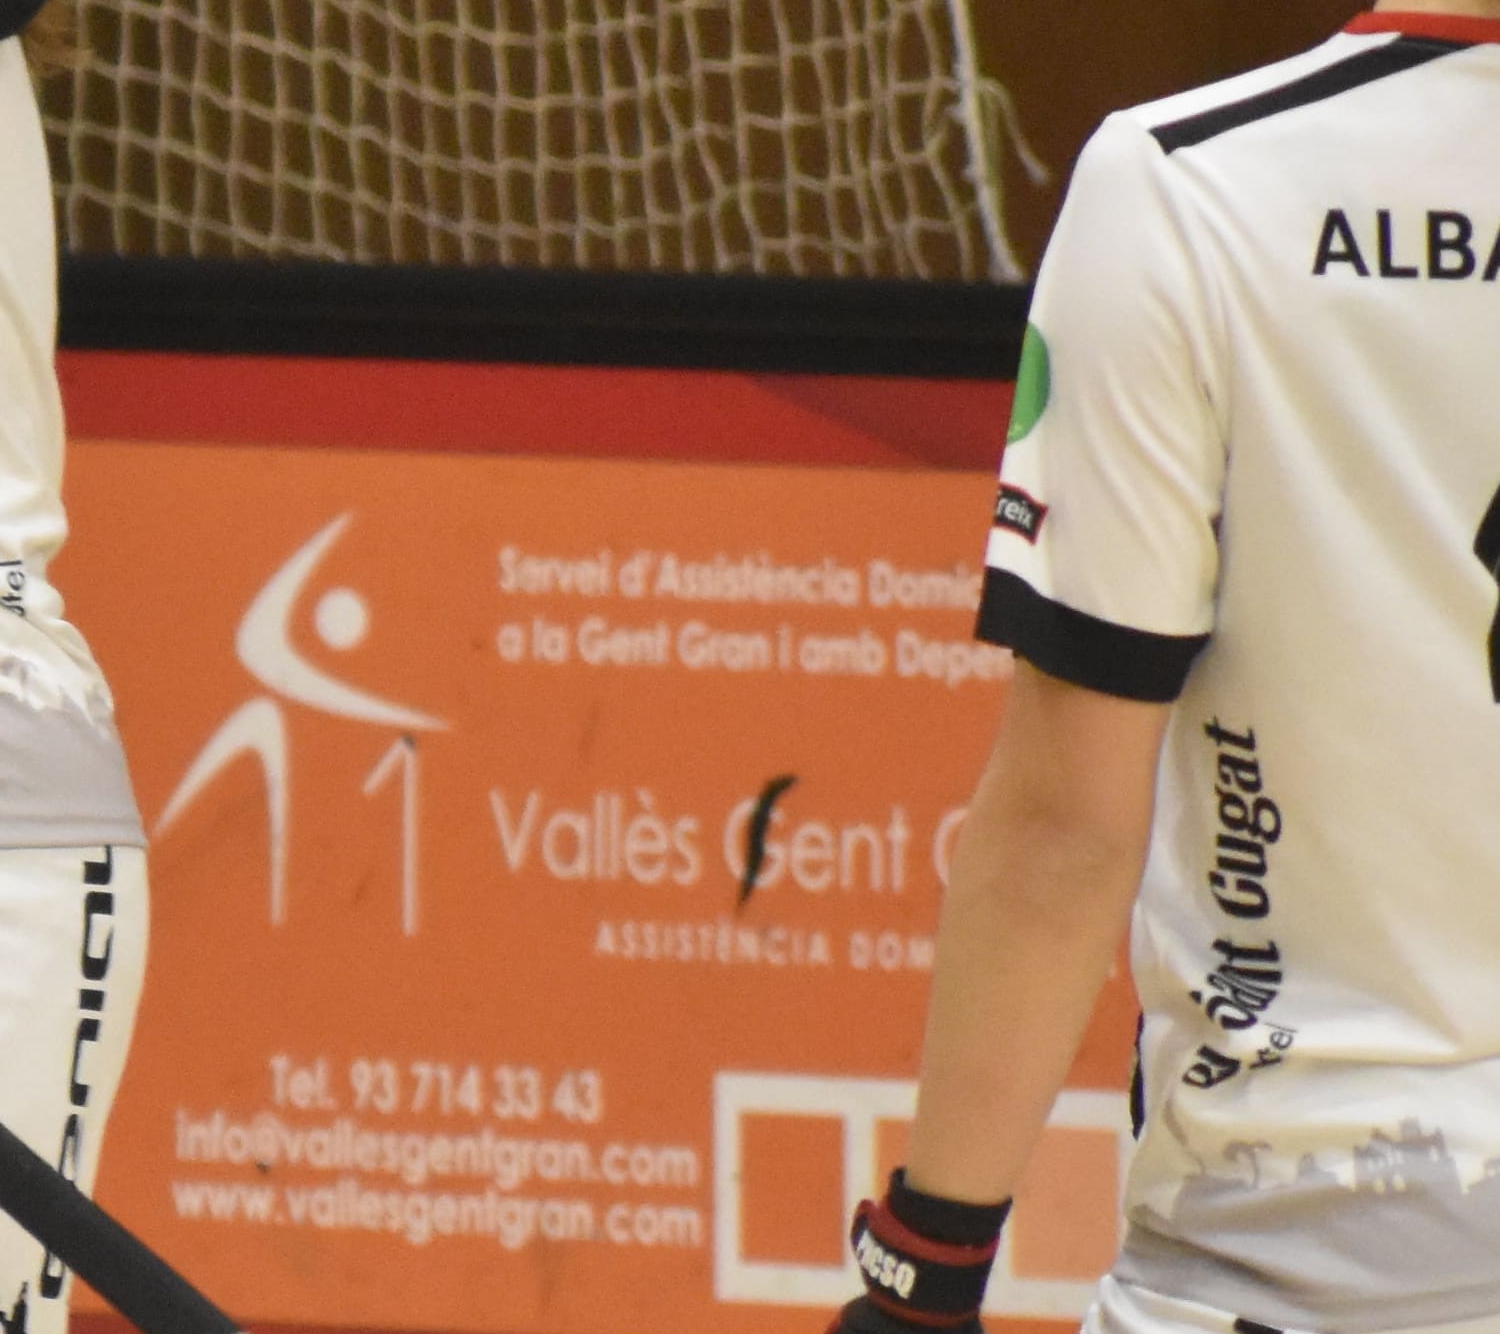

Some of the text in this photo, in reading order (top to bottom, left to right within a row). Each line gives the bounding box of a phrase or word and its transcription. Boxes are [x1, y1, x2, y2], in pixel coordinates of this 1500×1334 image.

[498, 546, 612, 596] Servei
[497, 623, 525, 664] a
[531, 616, 568, 664] la
[576, 616, 670, 667] Gent
[677, 619, 772, 670] Gran
[799, 629, 886, 676] amb
[489, 787, 700, 886] Vallès
[723, 798, 909, 893] Gent
[1203, 715, 1282, 920] Cugat
[849, 934, 936, 972] DOM
[271, 1053, 603, 1123] Tel. 93 714 33 43
[174, 1109, 698, 1188] info@vallesgentgran.com
[171, 1179, 701, 1250] www.vallesgentgran.com
